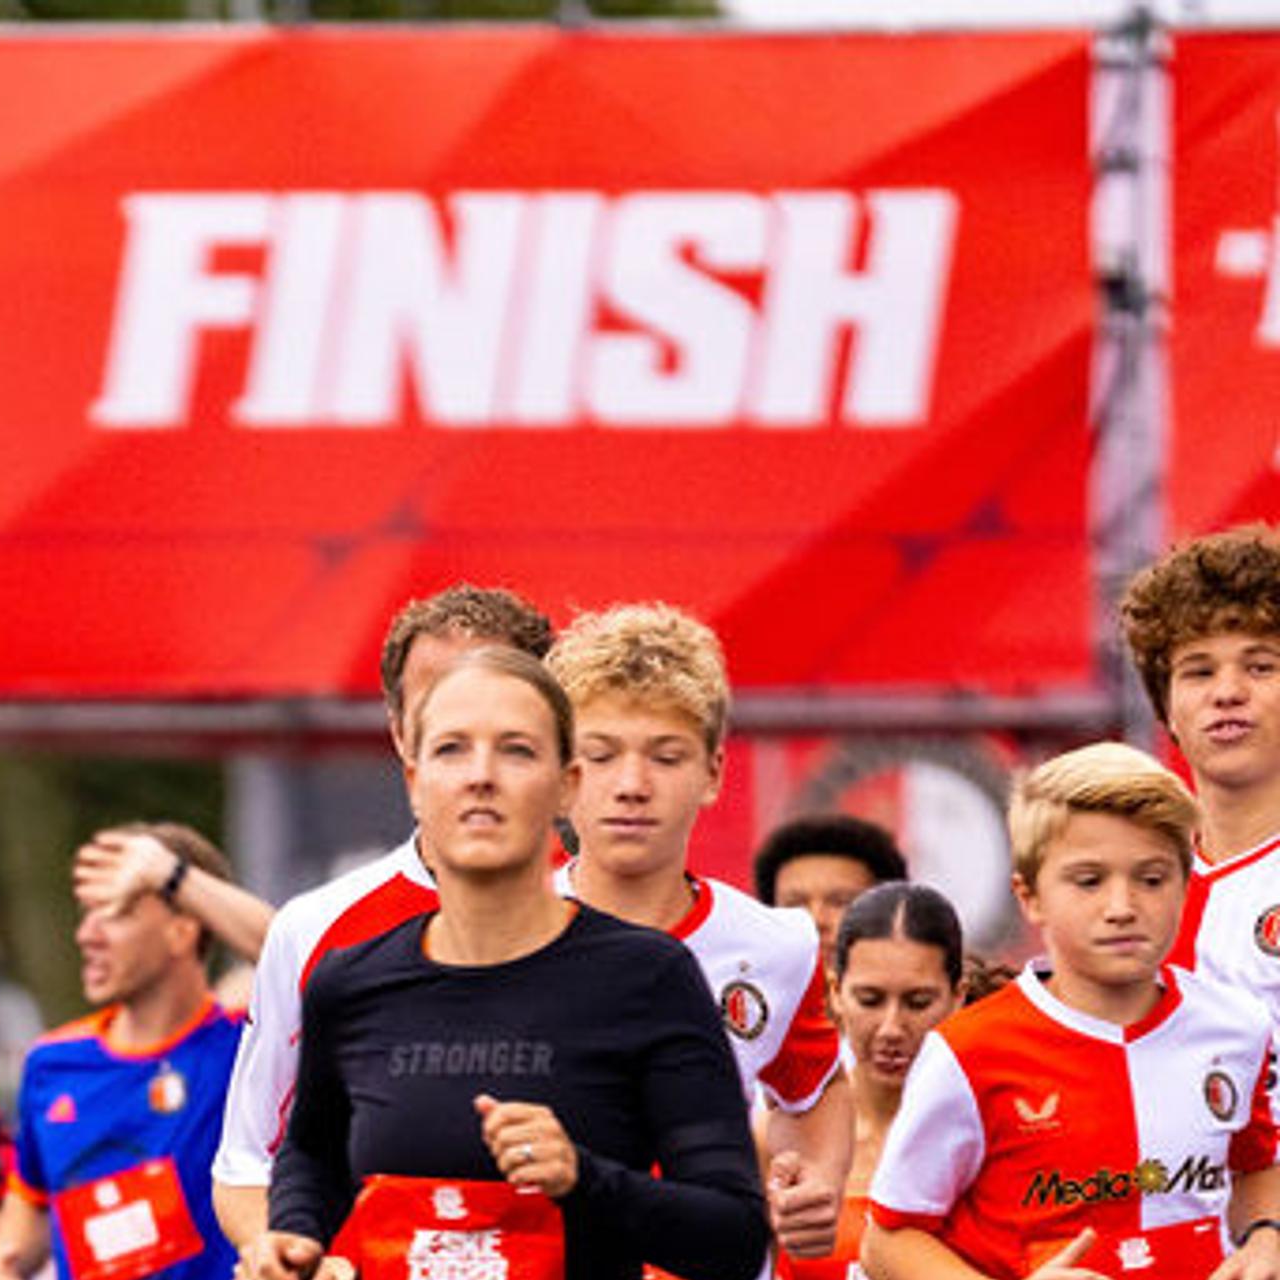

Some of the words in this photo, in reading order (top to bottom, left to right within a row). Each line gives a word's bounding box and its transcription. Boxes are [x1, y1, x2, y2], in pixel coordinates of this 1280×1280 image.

[88, 188, 958, 428] FINISH
[389, 1041, 556, 1078] STRONGER
[1021, 1169, 1131, 1206] Media
